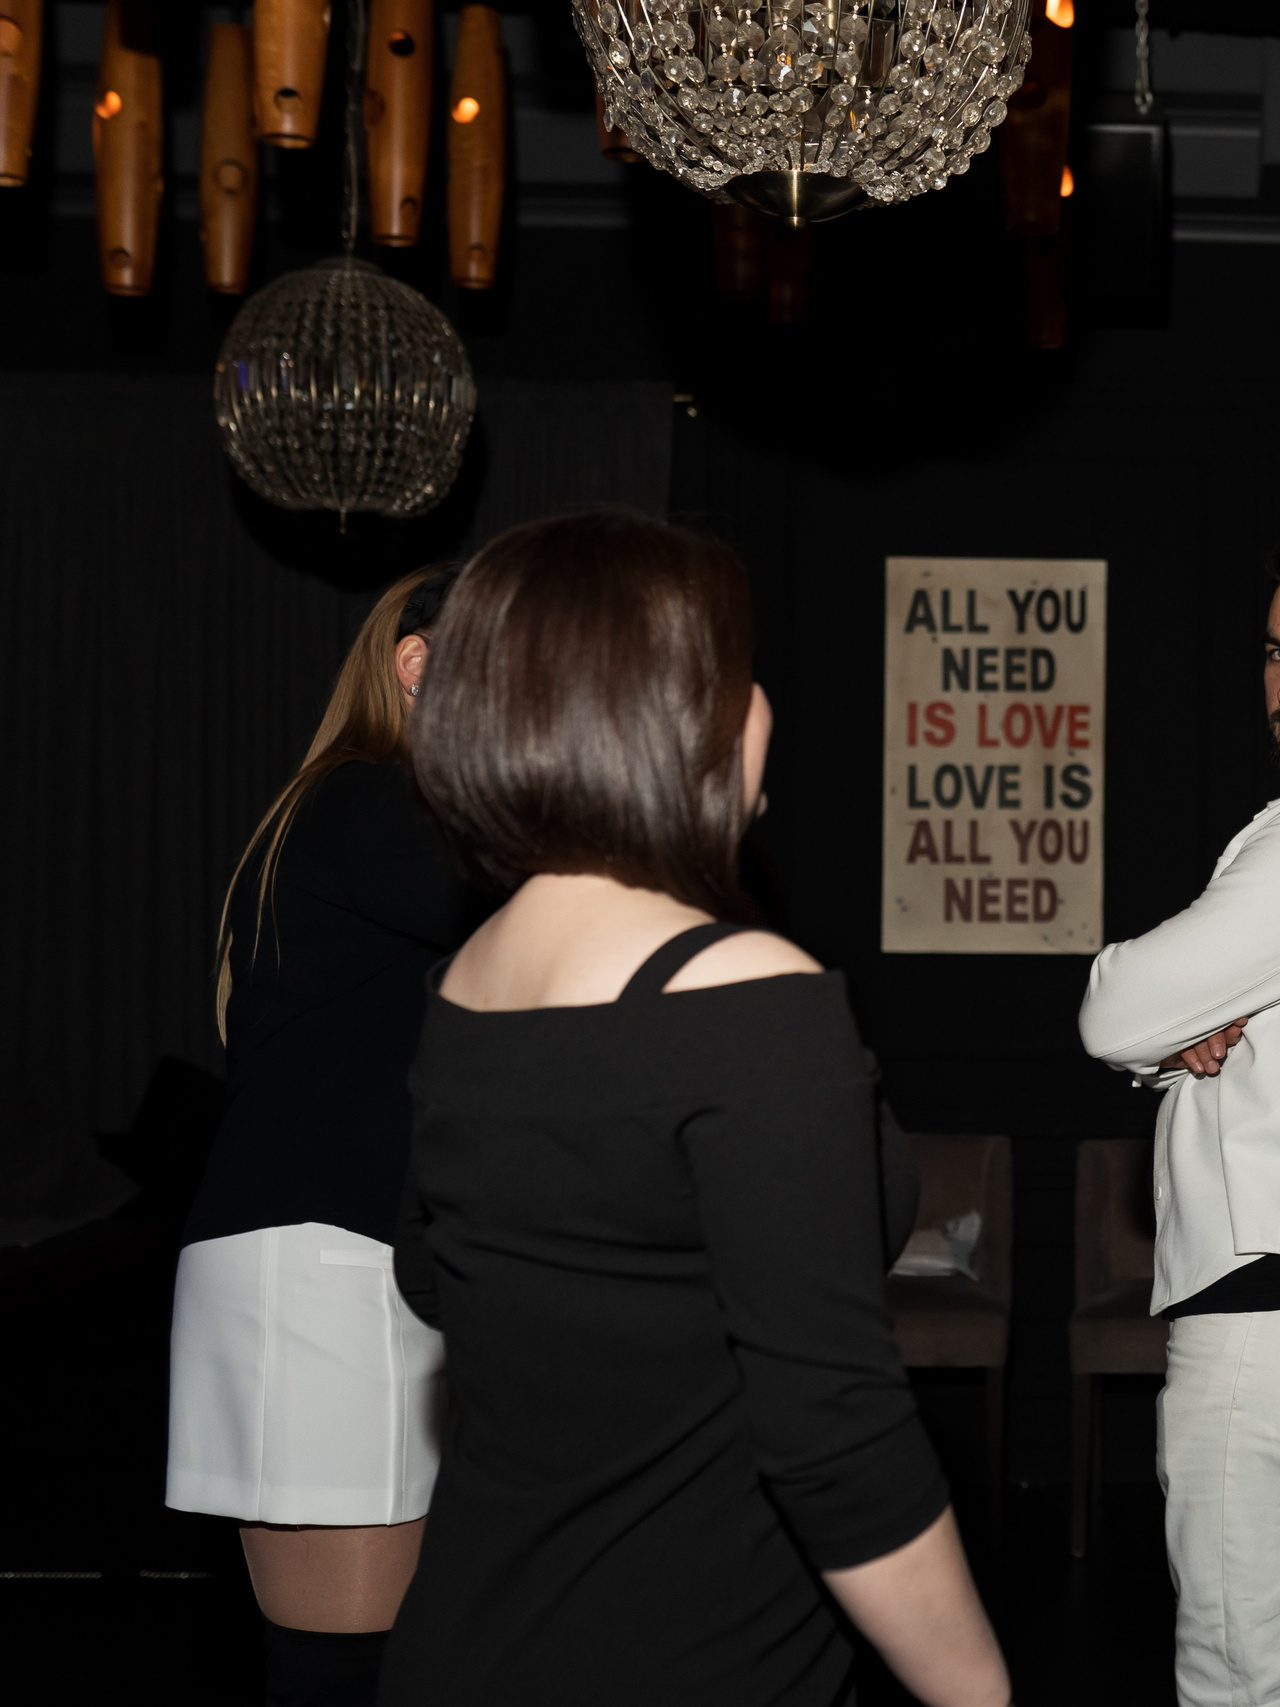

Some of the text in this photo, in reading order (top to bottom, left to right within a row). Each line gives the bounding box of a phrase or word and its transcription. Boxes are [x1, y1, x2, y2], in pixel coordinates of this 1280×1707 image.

[904, 588, 1087, 634] ALL YOU
[942, 648, 1056, 692] NEED
[906, 702, 1091, 750] IS LOVE
[907, 763, 1093, 810] LOVE IS
[906, 819, 1090, 865] ALL YOU
[943, 878, 1058, 923] NEED
